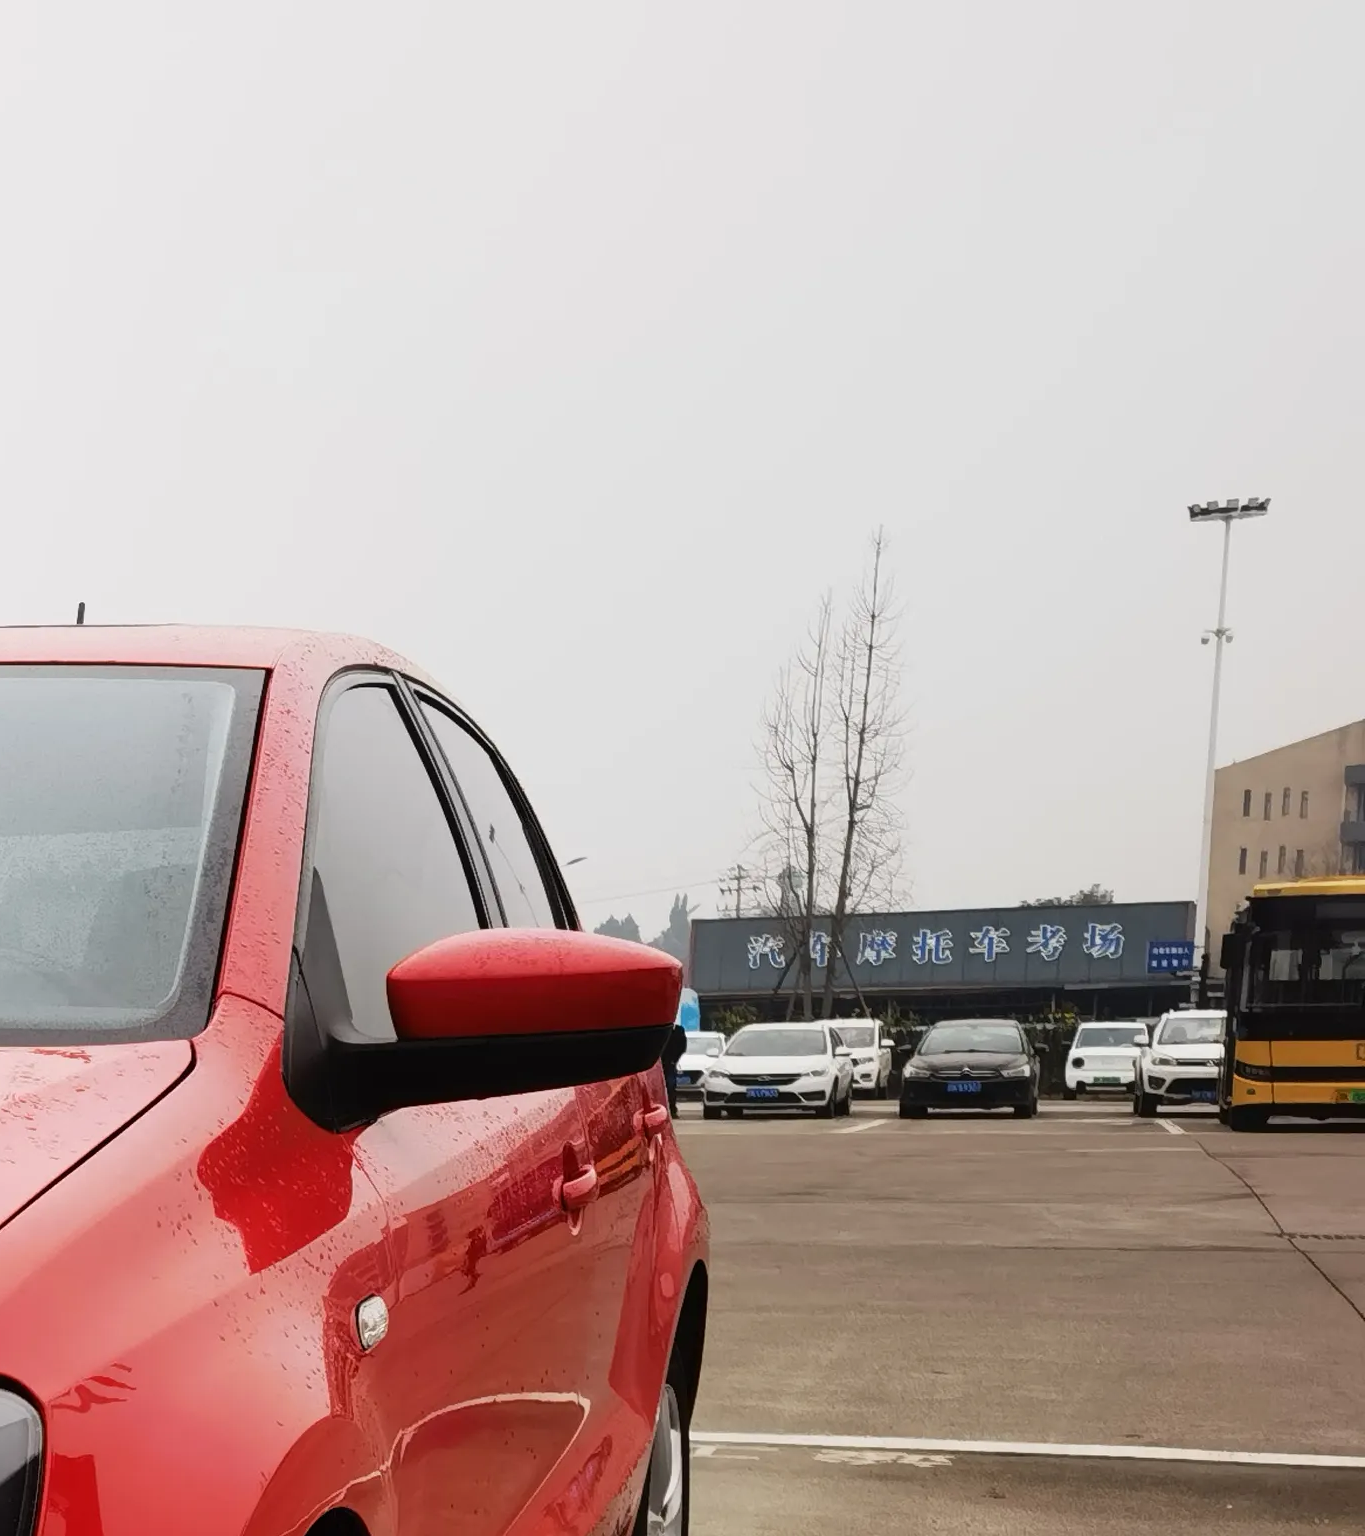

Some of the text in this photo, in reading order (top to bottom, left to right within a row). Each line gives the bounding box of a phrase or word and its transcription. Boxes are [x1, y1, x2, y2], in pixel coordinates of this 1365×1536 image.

[748, 922, 1126, 970] 汽车摩托车考场
